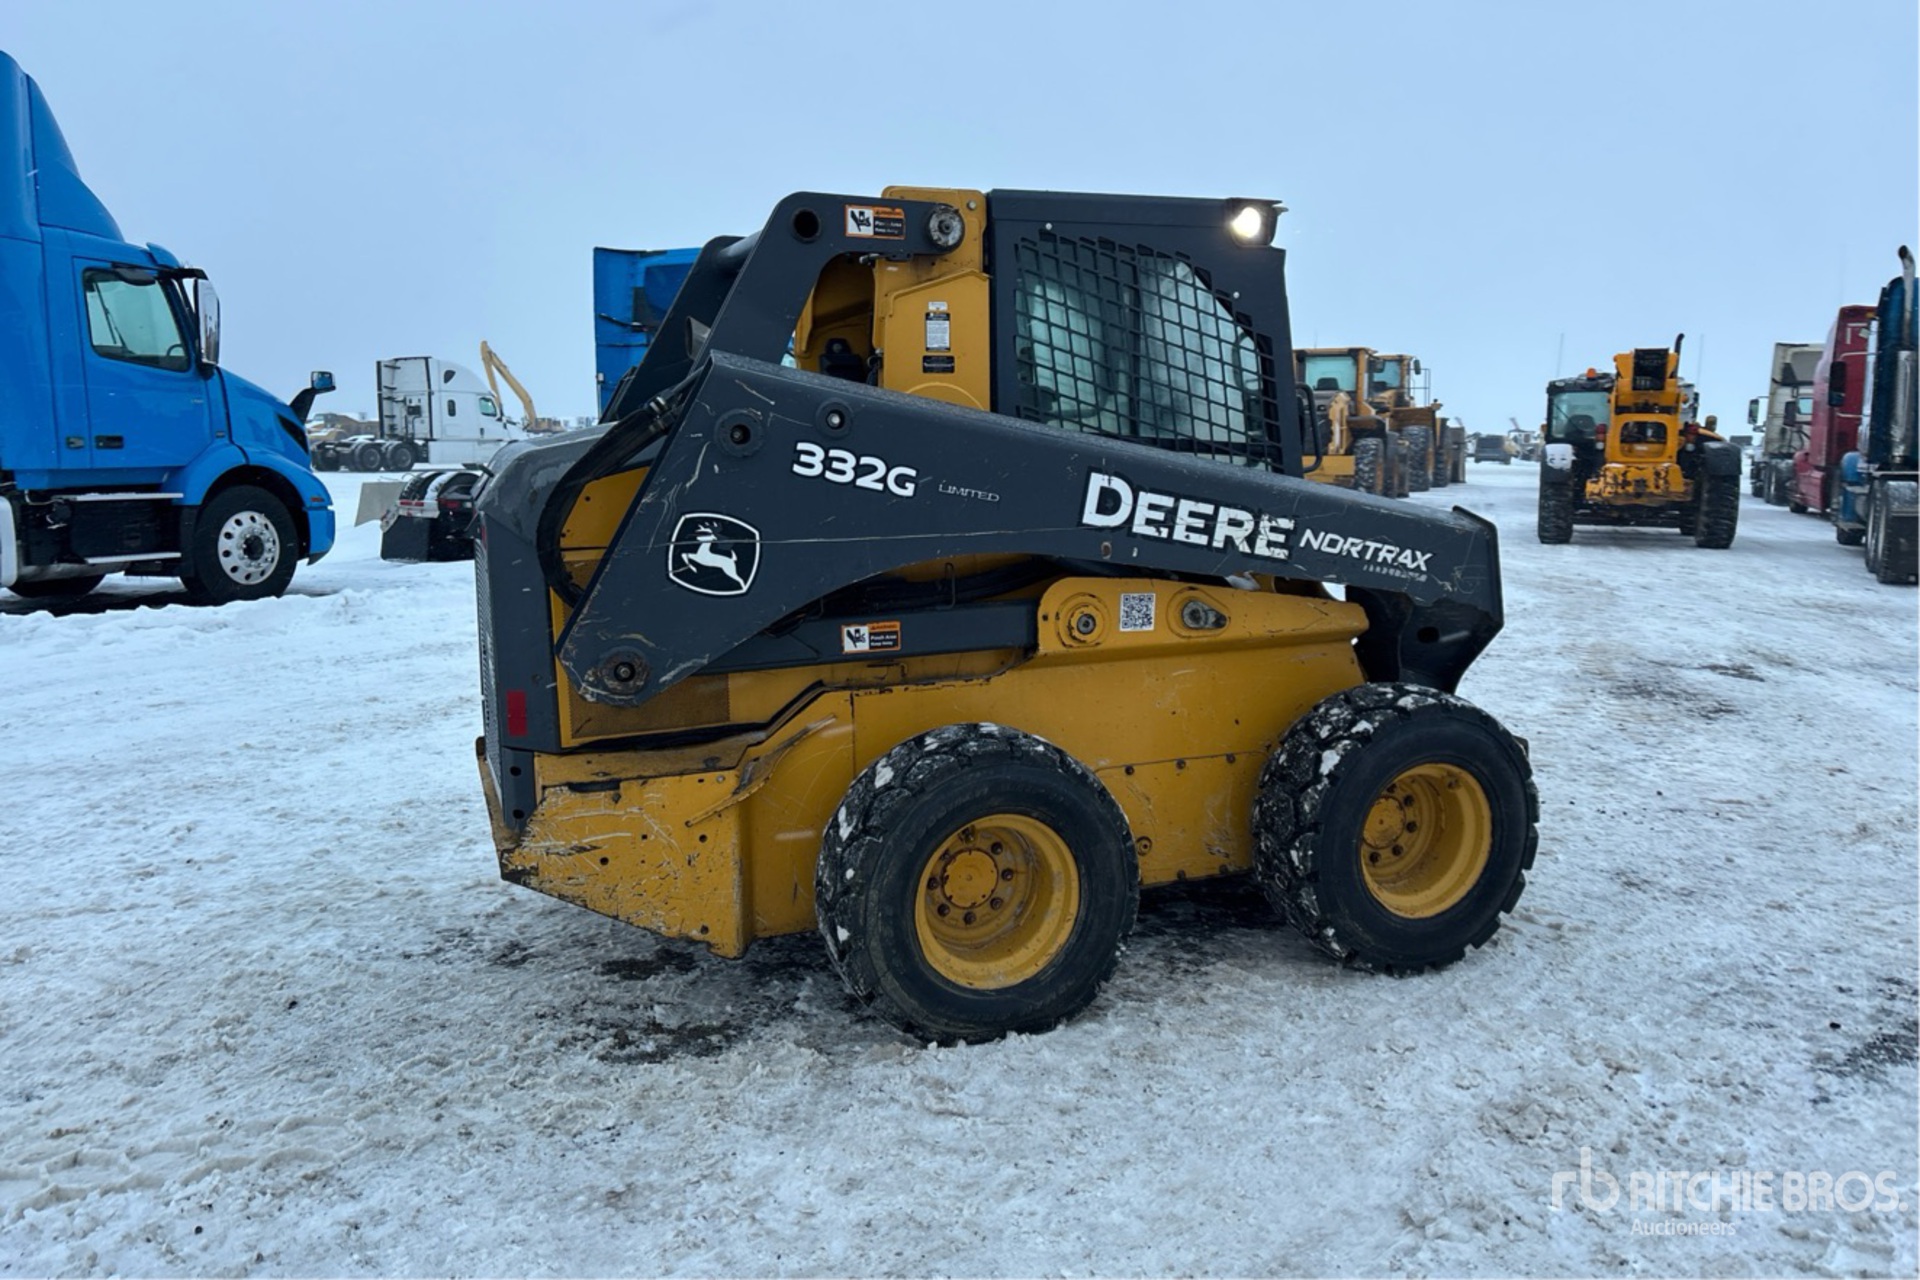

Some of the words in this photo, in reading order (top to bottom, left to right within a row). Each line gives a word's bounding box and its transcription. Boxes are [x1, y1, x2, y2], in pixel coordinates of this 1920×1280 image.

[792, 442, 917, 497] 332G
[938, 482, 1000, 502] LIMITED
[1082, 472, 1295, 560] DEERE
[1299, 528, 1433, 572] NORTRAX
